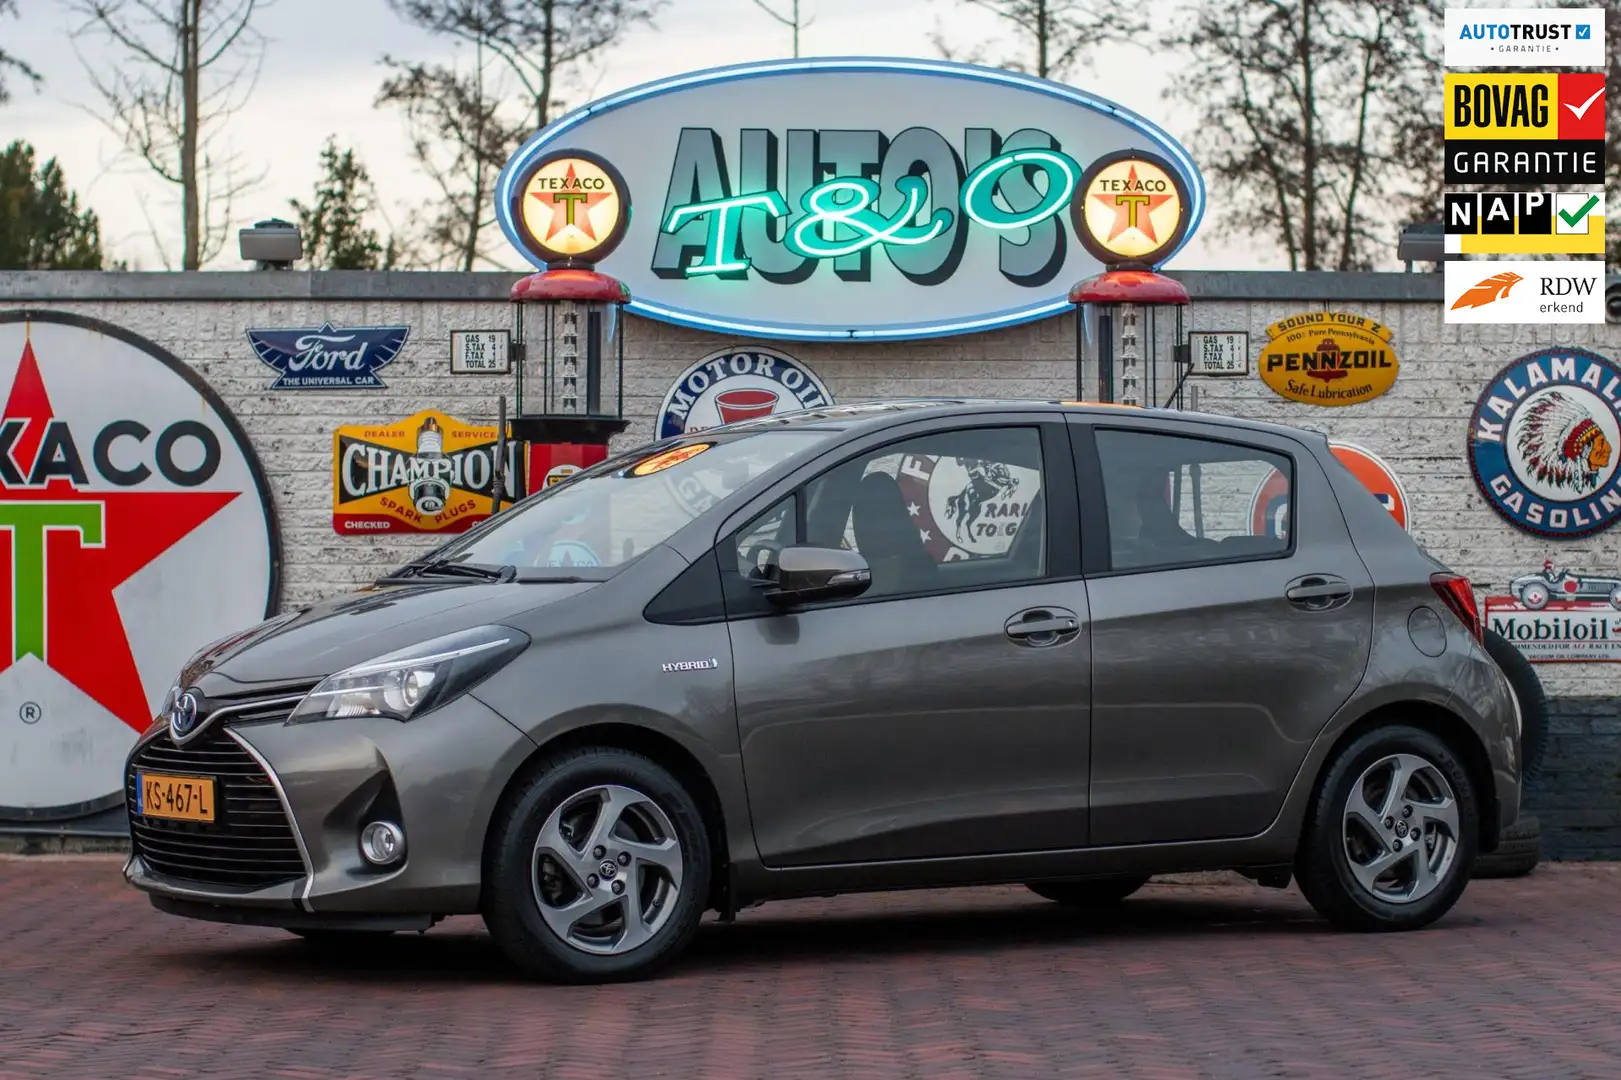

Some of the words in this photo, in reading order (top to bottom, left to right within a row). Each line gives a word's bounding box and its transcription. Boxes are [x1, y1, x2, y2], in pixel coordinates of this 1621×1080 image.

[538, 178, 605, 190] TEXACO
[1100, 179, 1166, 192] TEXACO
[553, 193, 588, 226] T
[1115, 195, 1150, 227] T
[1278, 313, 1324, 332] SOUND
[1329, 313, 1365, 327] YOUR
[1370, 322, 1381, 333] Z
[465, 334, 480, 343] GAS
[1203, 335, 1218, 344] GAS
[288, 334, 368, 372] Ford
[1267, 350, 1392, 372] PENNZOIL
[465, 360, 486, 369] TOTAL
[488, 360, 496, 369] 25
[1203, 361, 1224, 370] TOTAL
[1226, 361, 1235, 370] 25
[283, 377, 300, 386] THE
[302, 377, 353, 386] UNIVERSAL
[355, 376, 374, 385] CAR
[667, 353, 775, 418] MOTOR
[1285, 379, 1310, 396] Safe
[1311, 383, 1373, 400] Lubrication
[363, 430, 405, 438] DEALER
[451, 430, 497, 439] SERVICE
[341, 441, 516, 499] CHAMPION
[379, 497, 423, 524] SPARK
[434, 499, 476, 524] PLUGS
[1490, 474, 1621, 529] GASOLIN
[344, 521, 391, 529] CHECKED
[976, 523, 997, 537] TO
[1493, 617, 1609, 640] Mobiloil
[661, 660, 709, 672] HYBRID
[145, 780, 209, 815] KS-467-L
